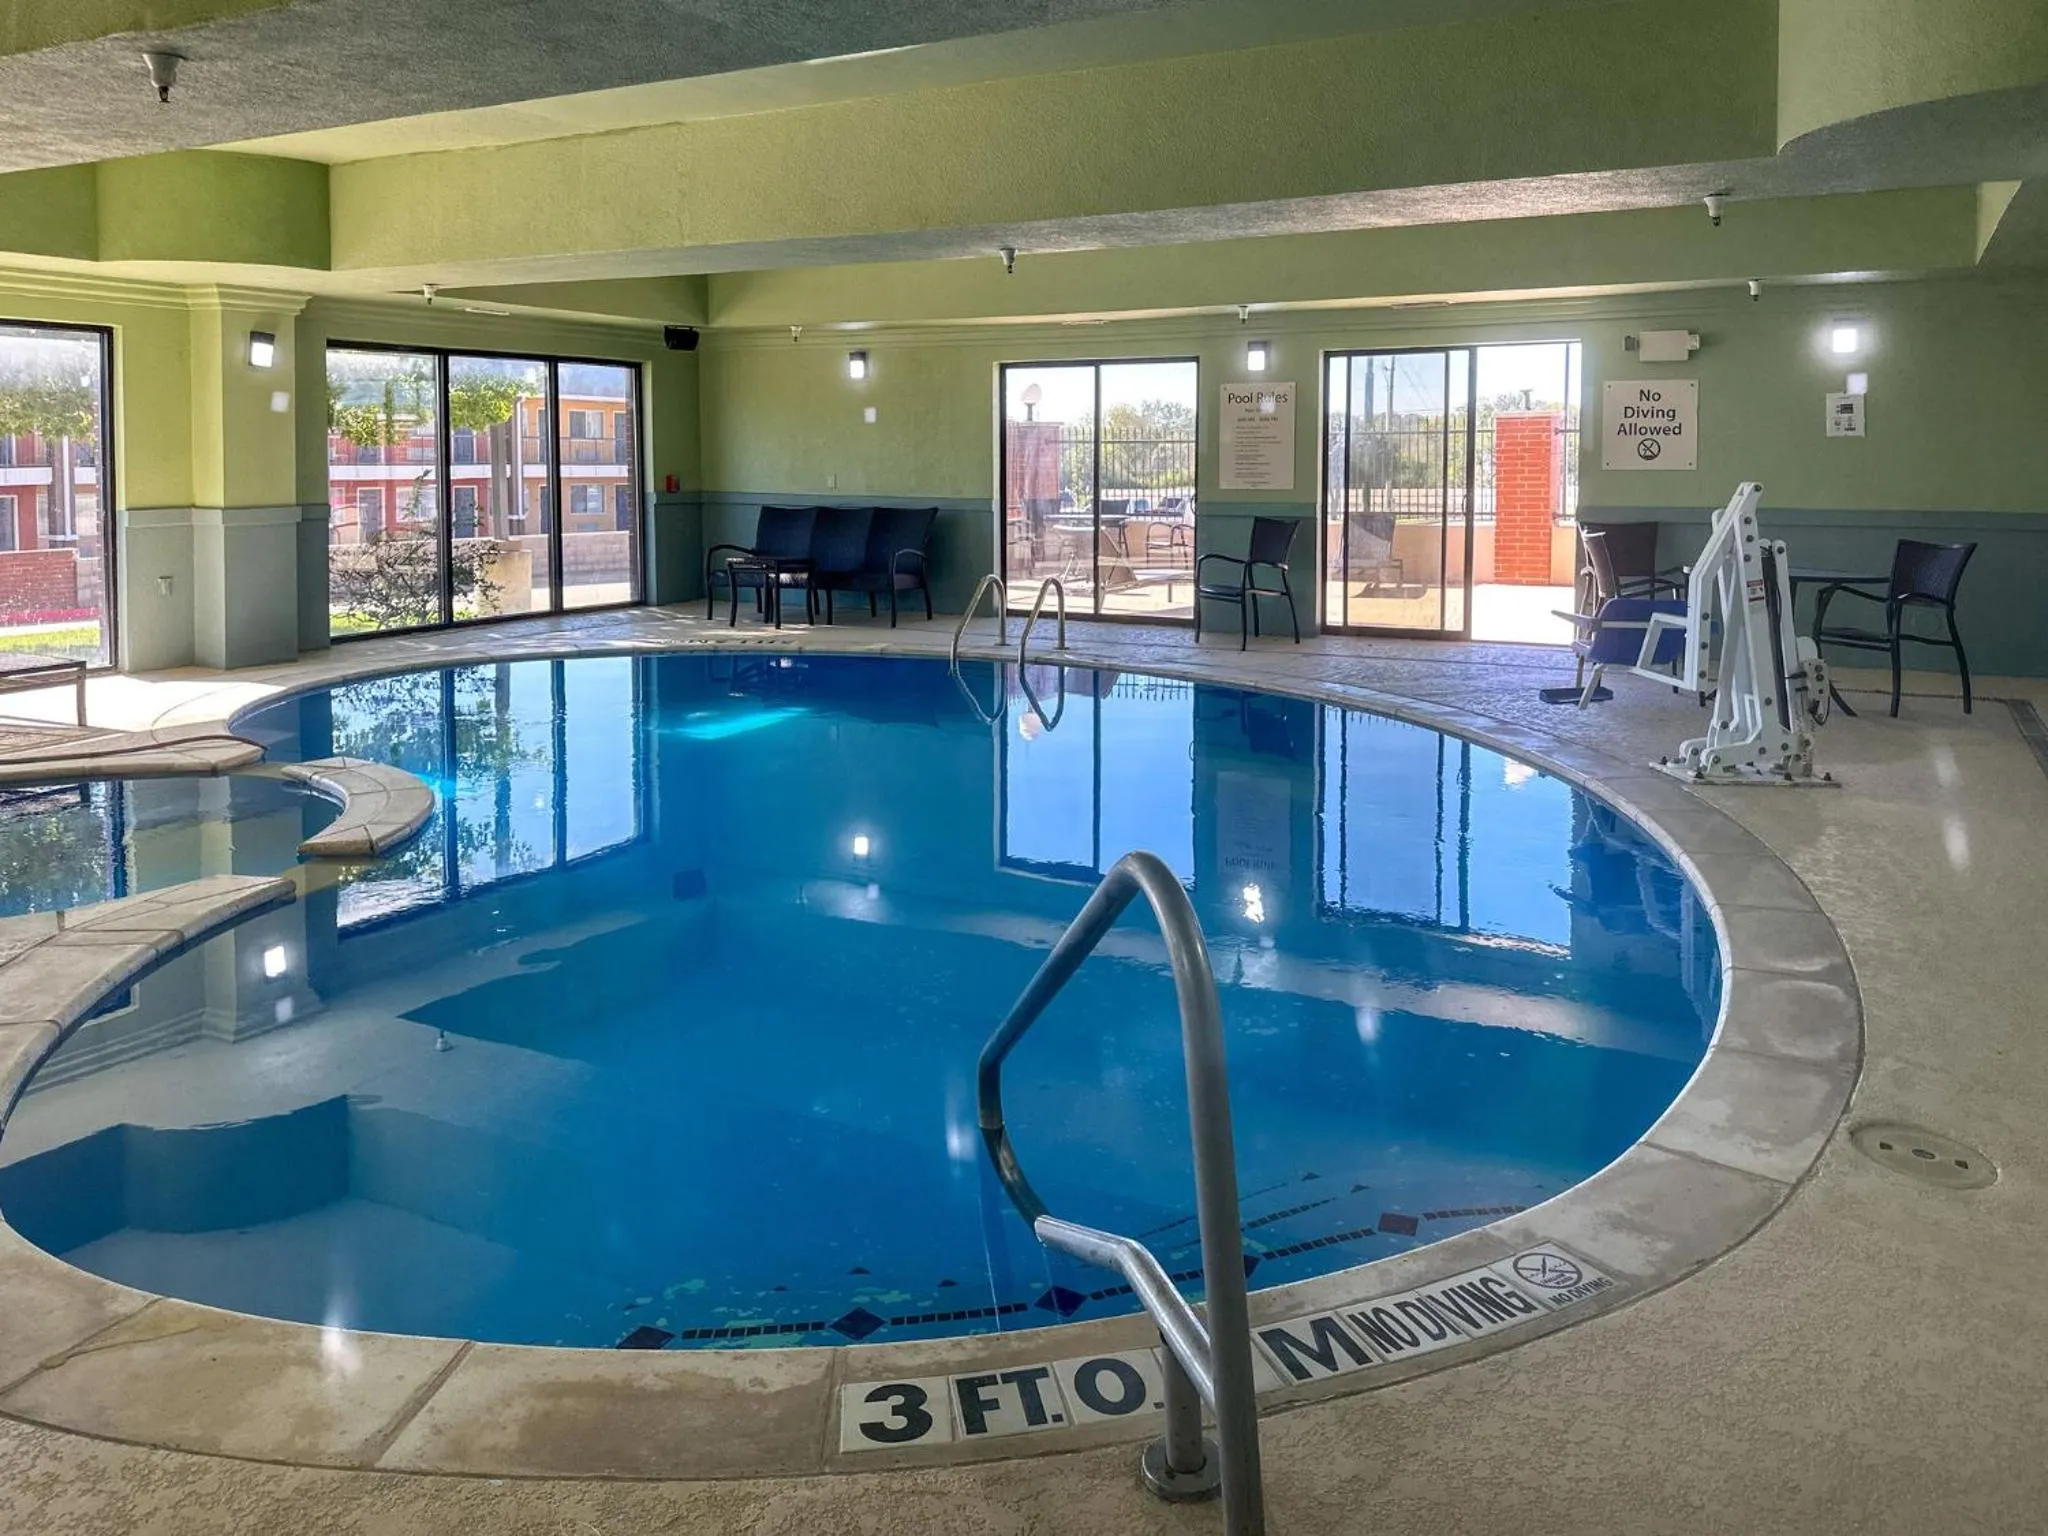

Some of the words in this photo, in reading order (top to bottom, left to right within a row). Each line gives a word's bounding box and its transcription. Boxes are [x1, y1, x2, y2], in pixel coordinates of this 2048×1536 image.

[1228, 392, 1253, 405] Pool
[1639, 389, 1661, 402] No
[1623, 405, 1676, 422] Diving
[1617, 422, 1682, 436] Allowed
[1548, 1291, 1574, 1306] NO
[1566, 1277, 1614, 1301] DIVING
[1347, 1306, 1421, 1354] NO
[1393, 1276, 1539, 1342] DIVING
[859, 1383, 933, 1444] 3
[955, 1367, 1064, 1436] FT.
[1258, 1315, 1374, 1380] M
